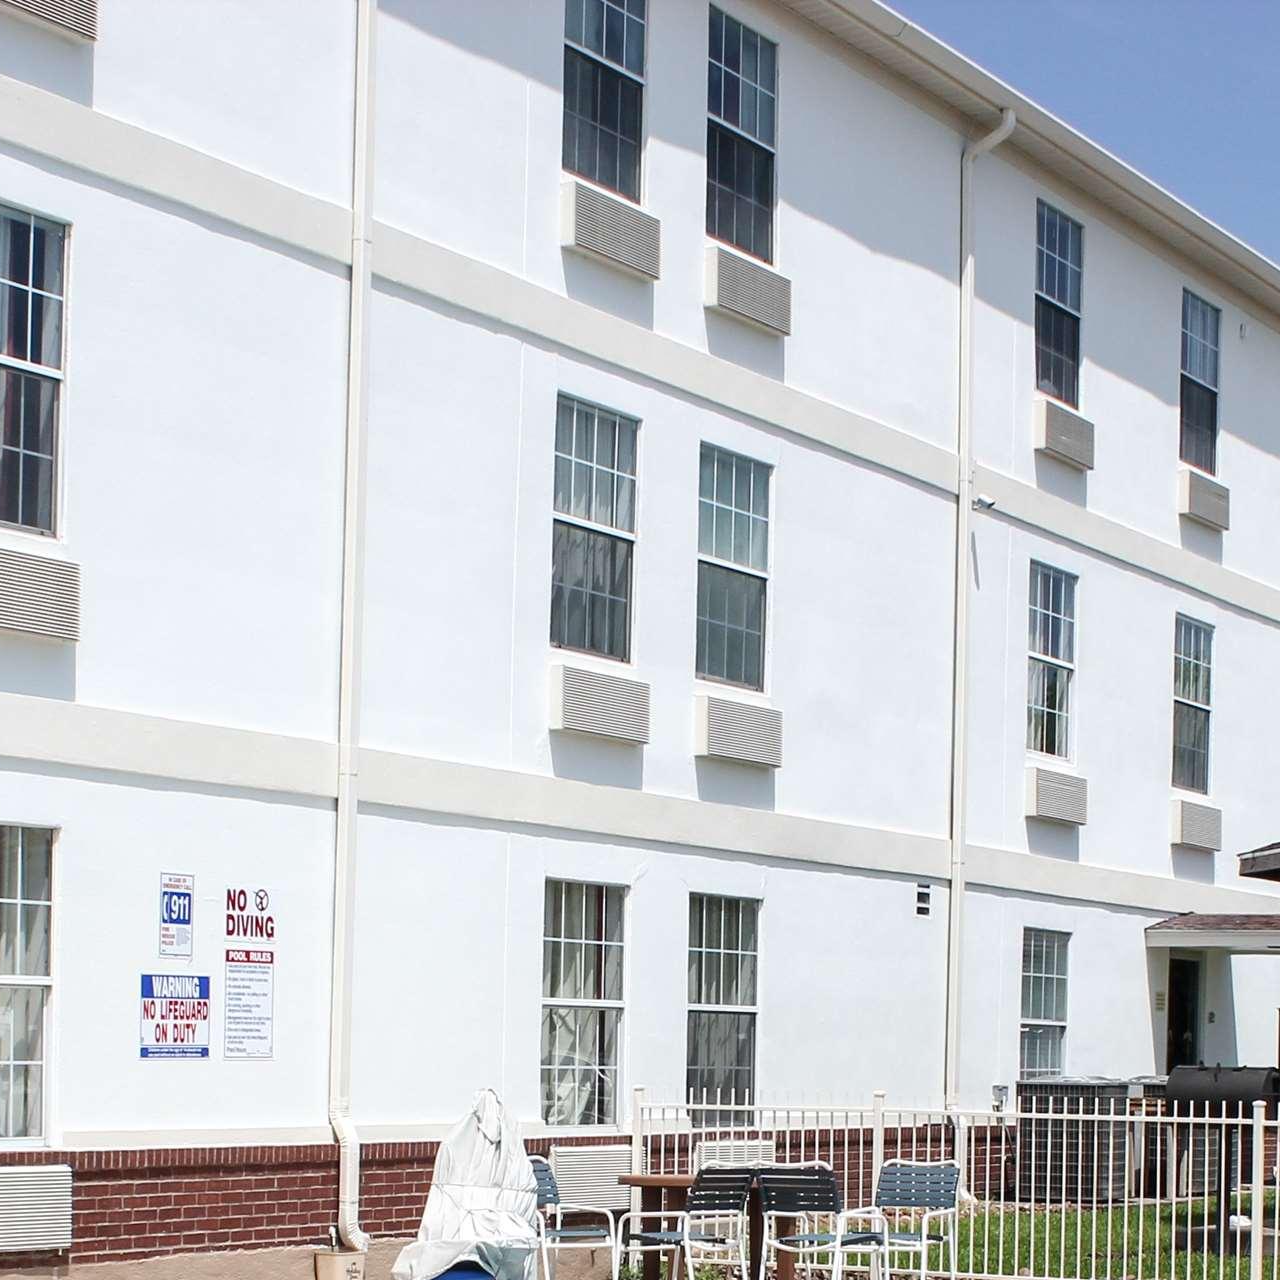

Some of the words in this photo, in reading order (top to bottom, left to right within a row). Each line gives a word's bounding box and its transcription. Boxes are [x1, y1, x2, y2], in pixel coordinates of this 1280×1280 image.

[171, 895, 190, 920] 911
[227, 889, 247, 911] NO
[227, 914, 275, 938] DIVING
[228, 951, 248, 961] POOL
[249, 952, 271, 962] RULES
[152, 976, 200, 998] WARNING
[143, 1000, 156, 1020] NO
[161, 1000, 208, 1020] LIFEGUARD
[155, 1023, 167, 1043] ON
[173, 1023, 197, 1043] DUTY
